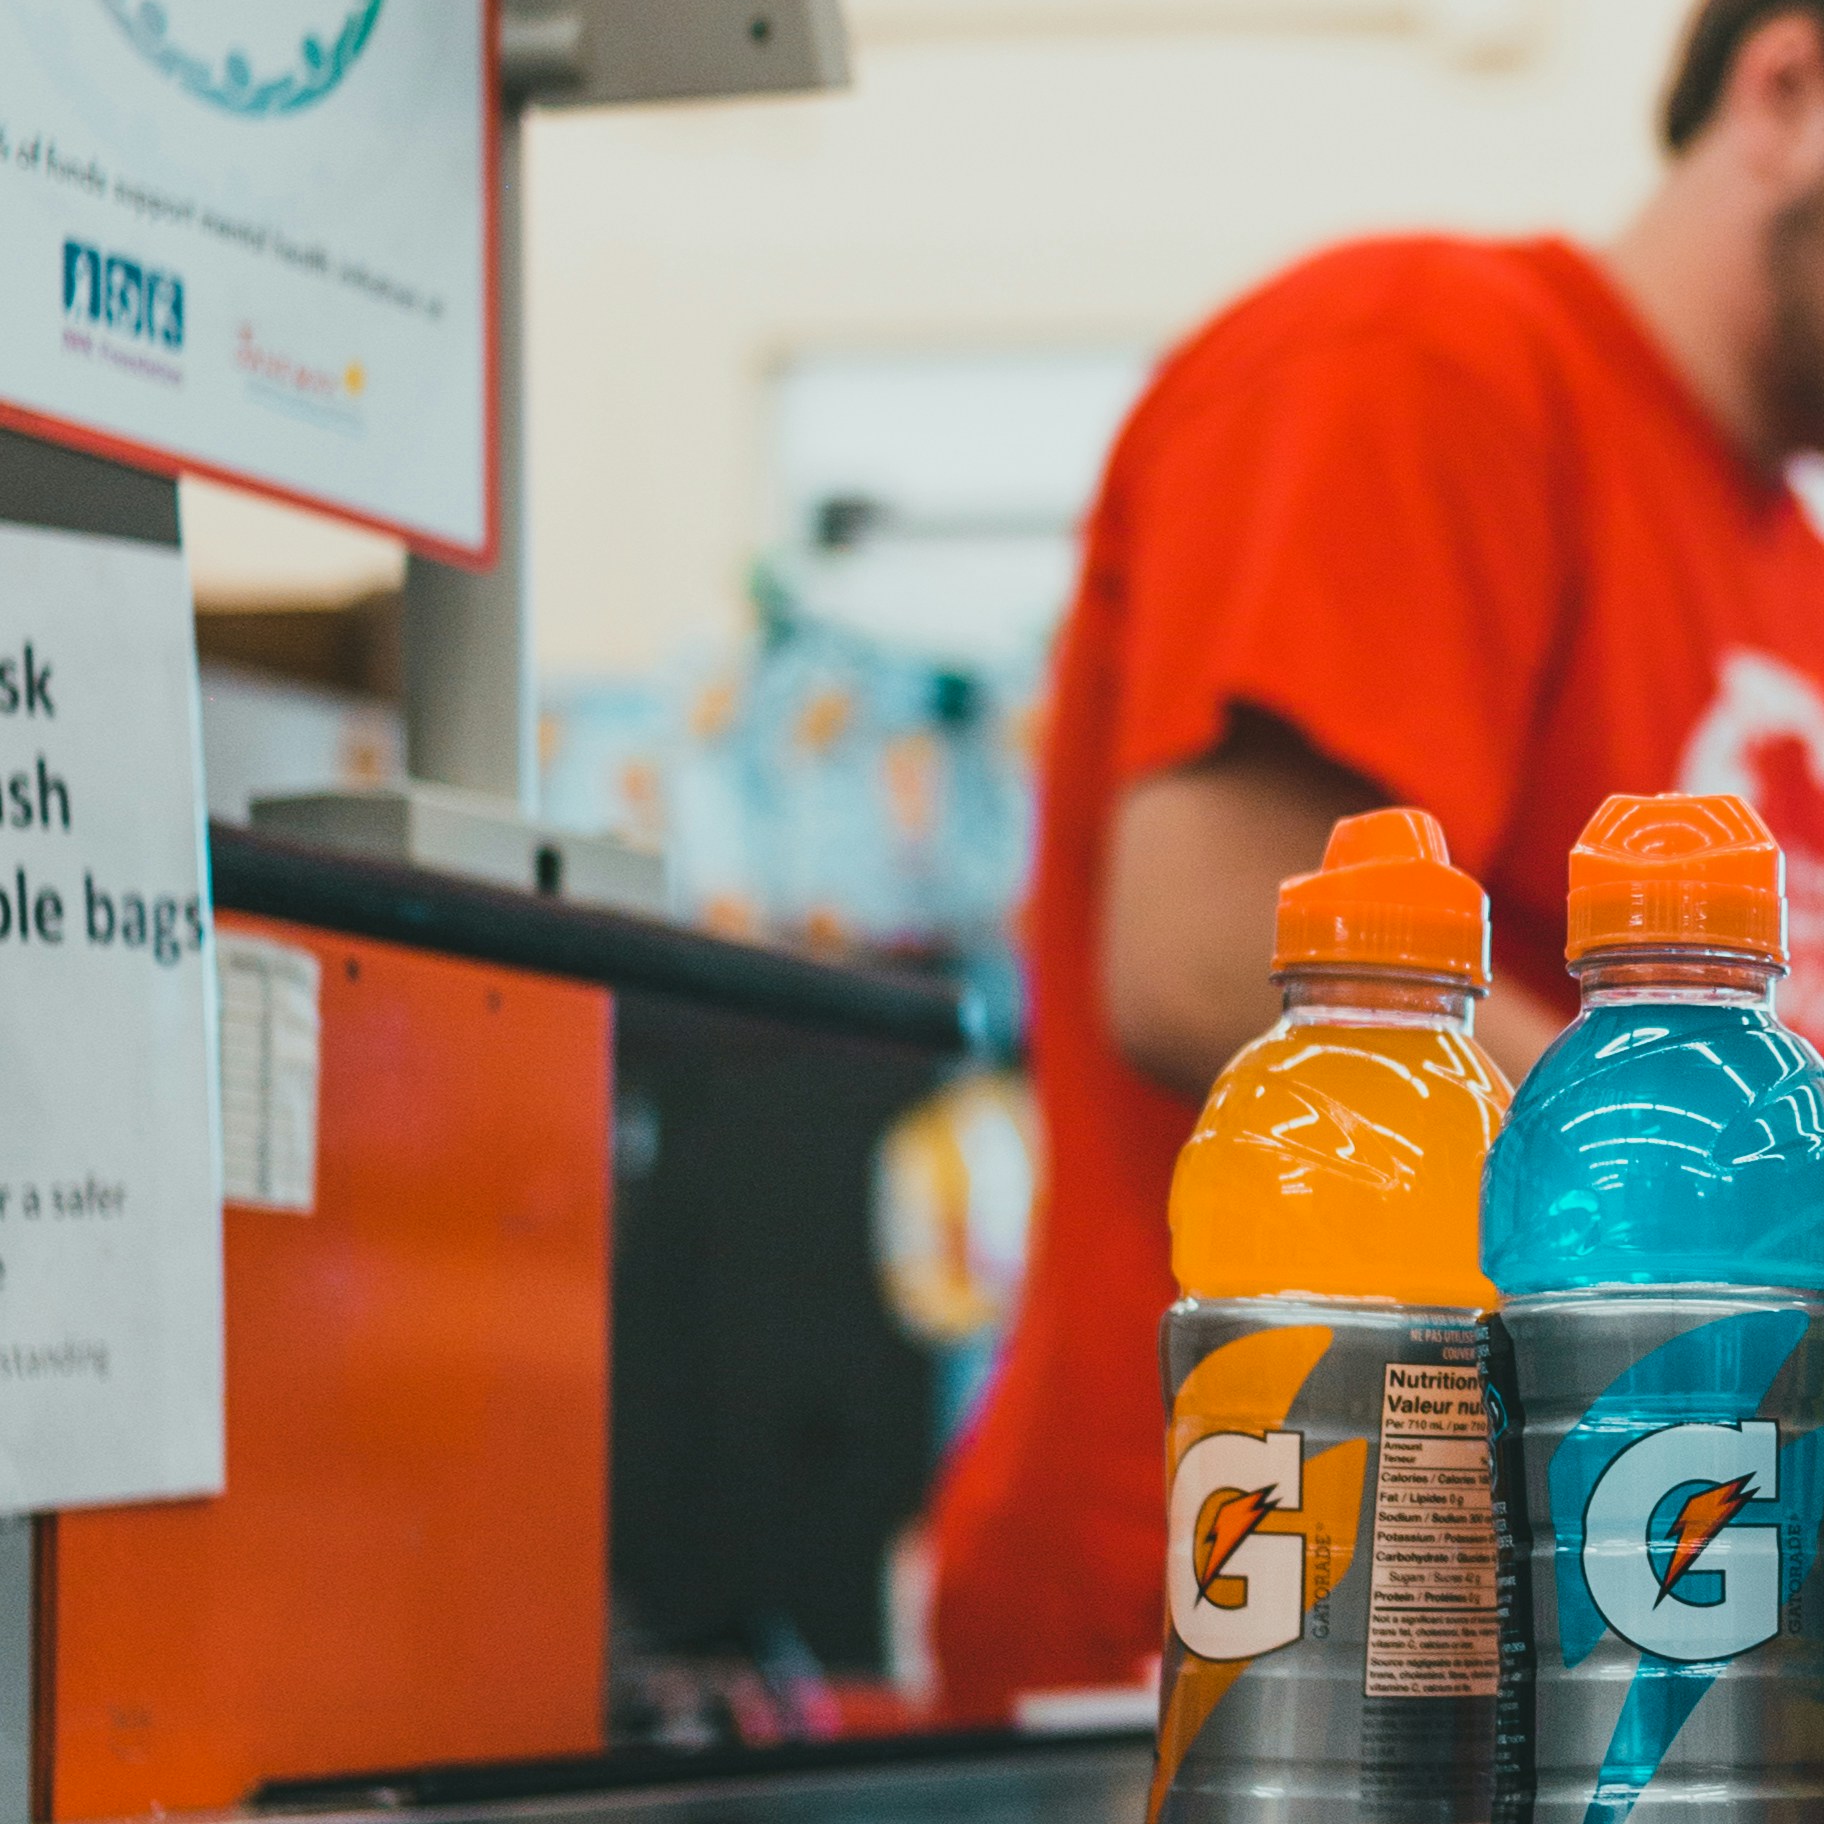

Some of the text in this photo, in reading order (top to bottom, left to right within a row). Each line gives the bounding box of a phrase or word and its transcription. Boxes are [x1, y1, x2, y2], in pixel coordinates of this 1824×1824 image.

[0, 754, 70, 833] sh
[1390, 1369, 1479, 1390] Nutrition
[1388, 1395, 1452, 1414] Valeur
[1408, 1420, 1427, 1429] 710
[1384, 1442, 1423, 1451] Amount
[1168, 1430, 1306, 1663] G
[1580, 1418, 1780, 1663] G
